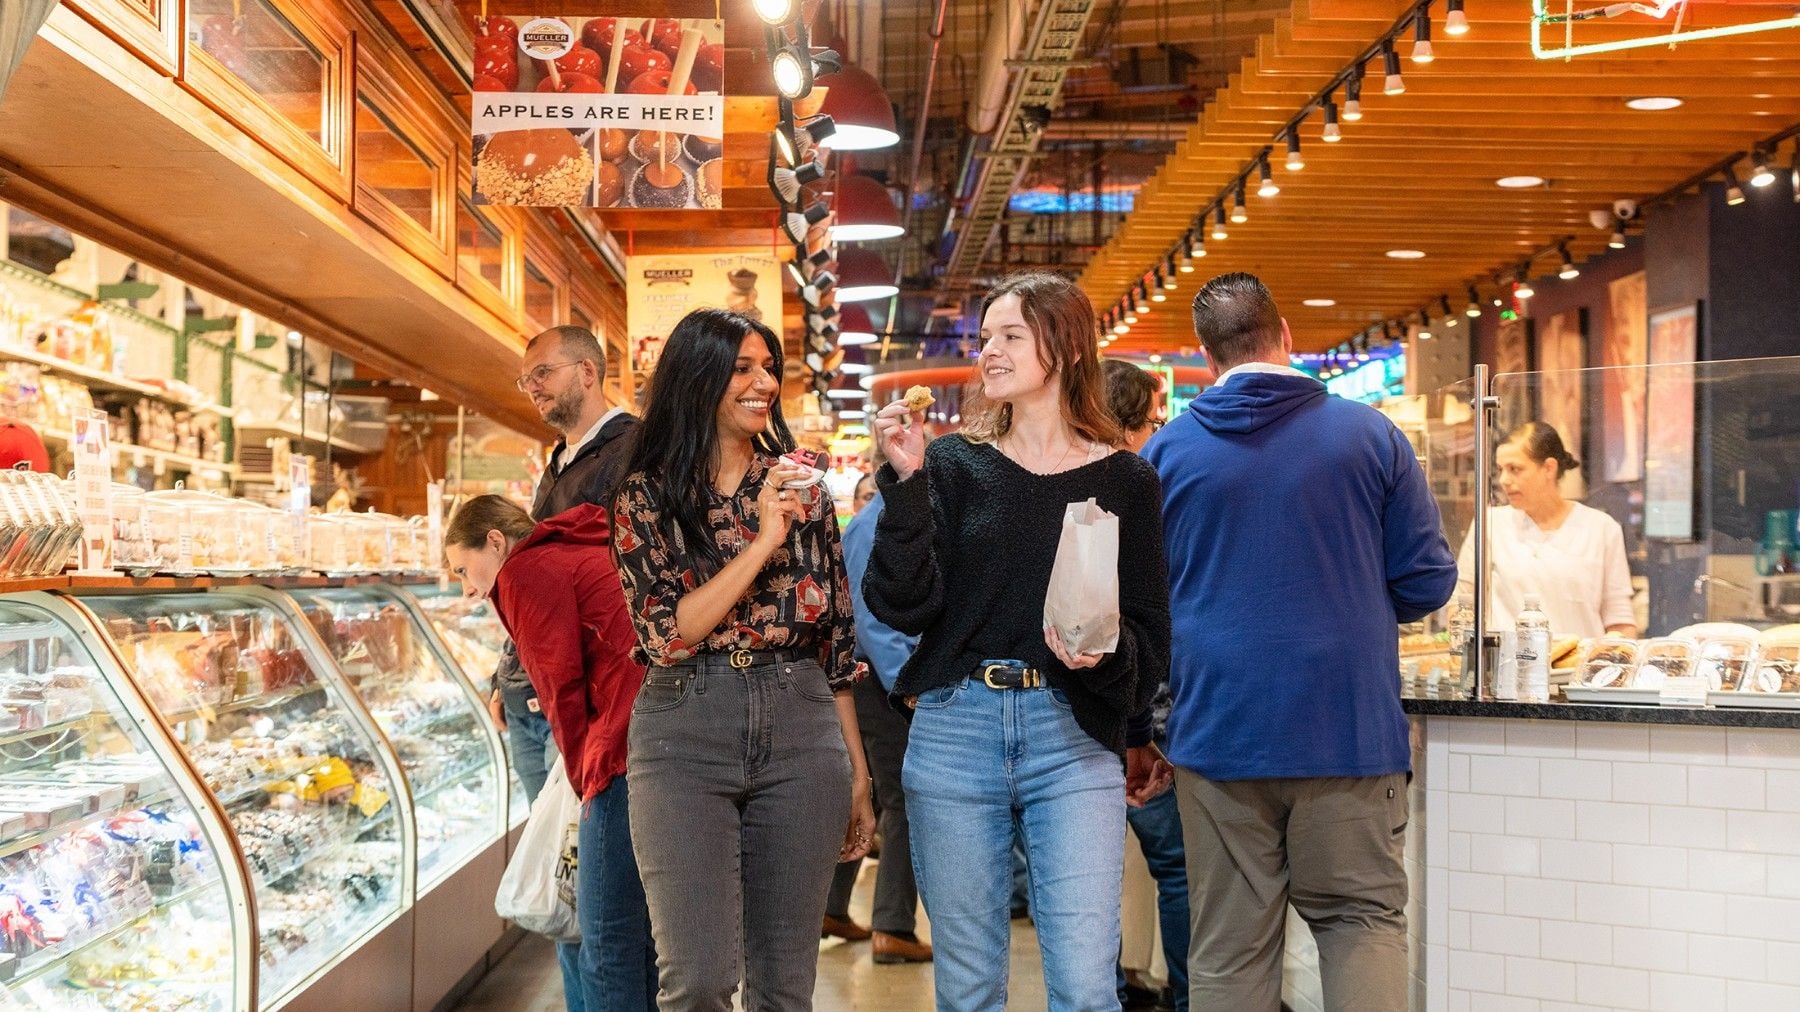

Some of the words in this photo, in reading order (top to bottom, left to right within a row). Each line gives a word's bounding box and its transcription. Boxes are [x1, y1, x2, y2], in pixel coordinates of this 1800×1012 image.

[482, 104, 575, 119] APPLES
[584, 105, 630, 120] ARE
[641, 106, 715, 121] HERE!
